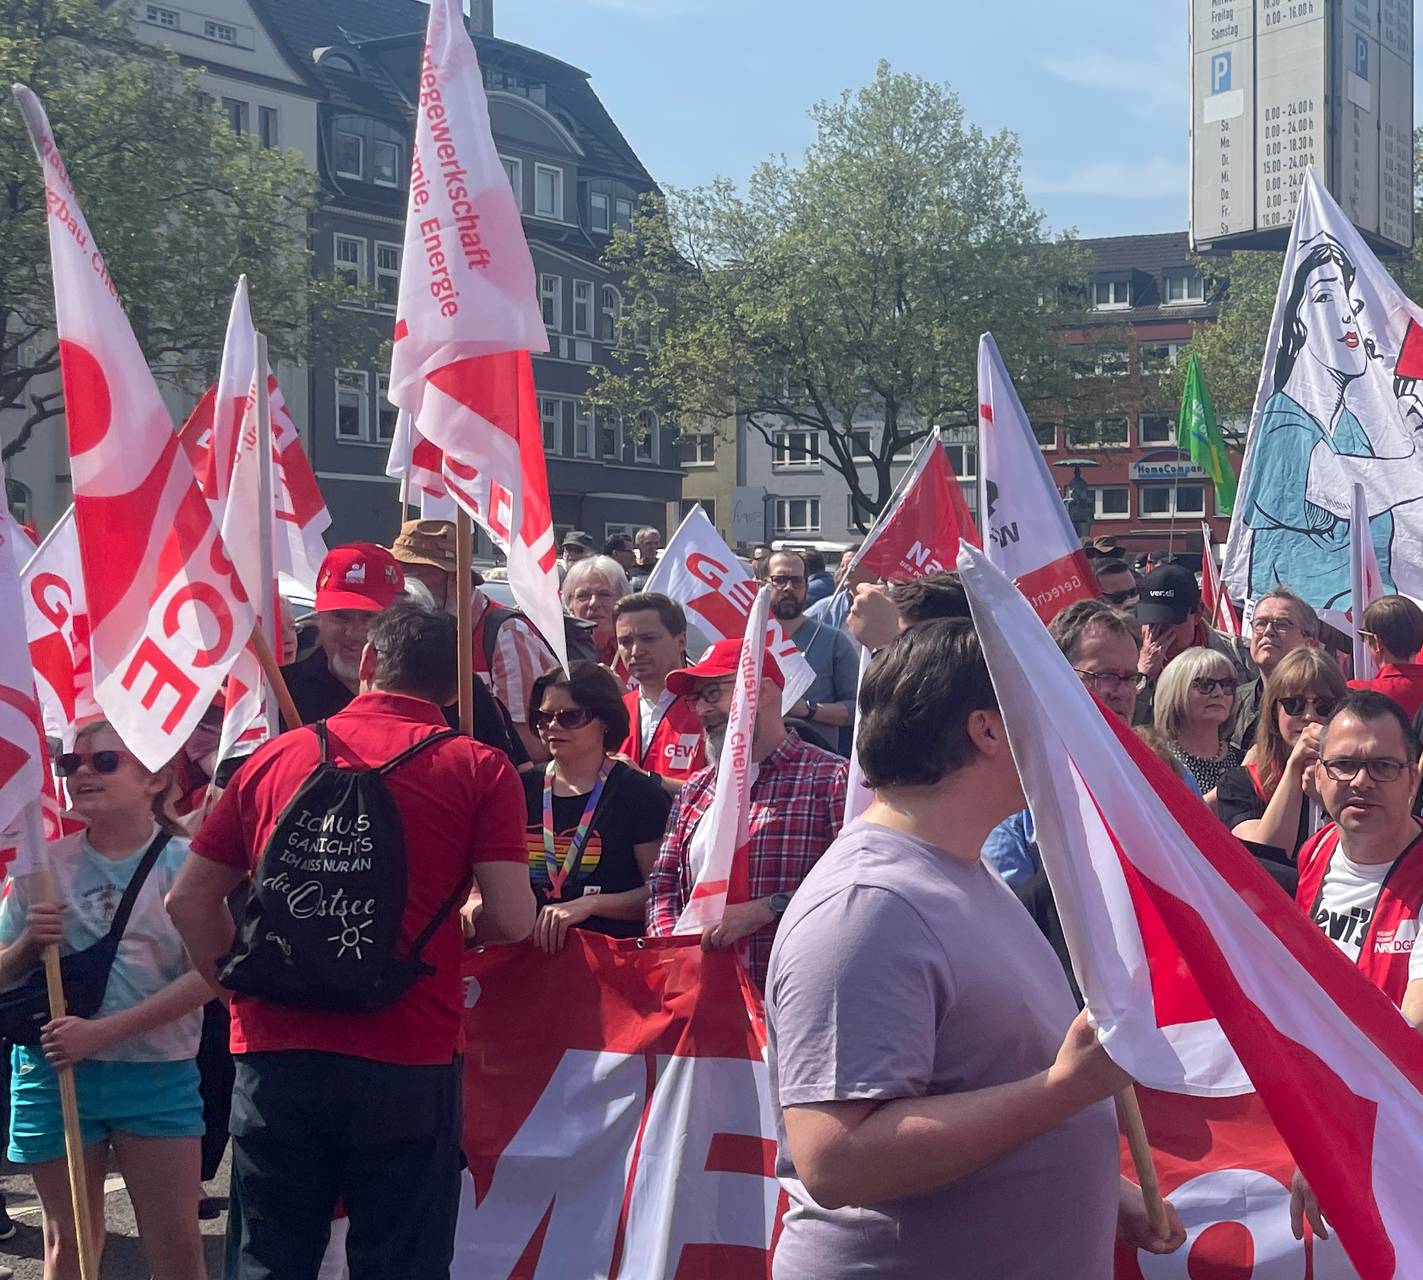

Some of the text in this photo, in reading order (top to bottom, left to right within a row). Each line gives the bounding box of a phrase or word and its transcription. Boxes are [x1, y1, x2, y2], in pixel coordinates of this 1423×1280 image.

[1211, 9, 1234, 23] Freitag
[1211, 24, 1239, 41] Samstag
[1215, 56, 1228, 91] P
[420, 216, 459, 318] Energie
[1137, 463, 1207, 475] HomeCompany
[1149, 589, 1175, 598] ver.di
[664, 743, 700, 759] GEW
[322, 859, 350, 873] NUR
[350, 857, 372, 872] AN
[262, 872, 376, 919] die Ostsee
